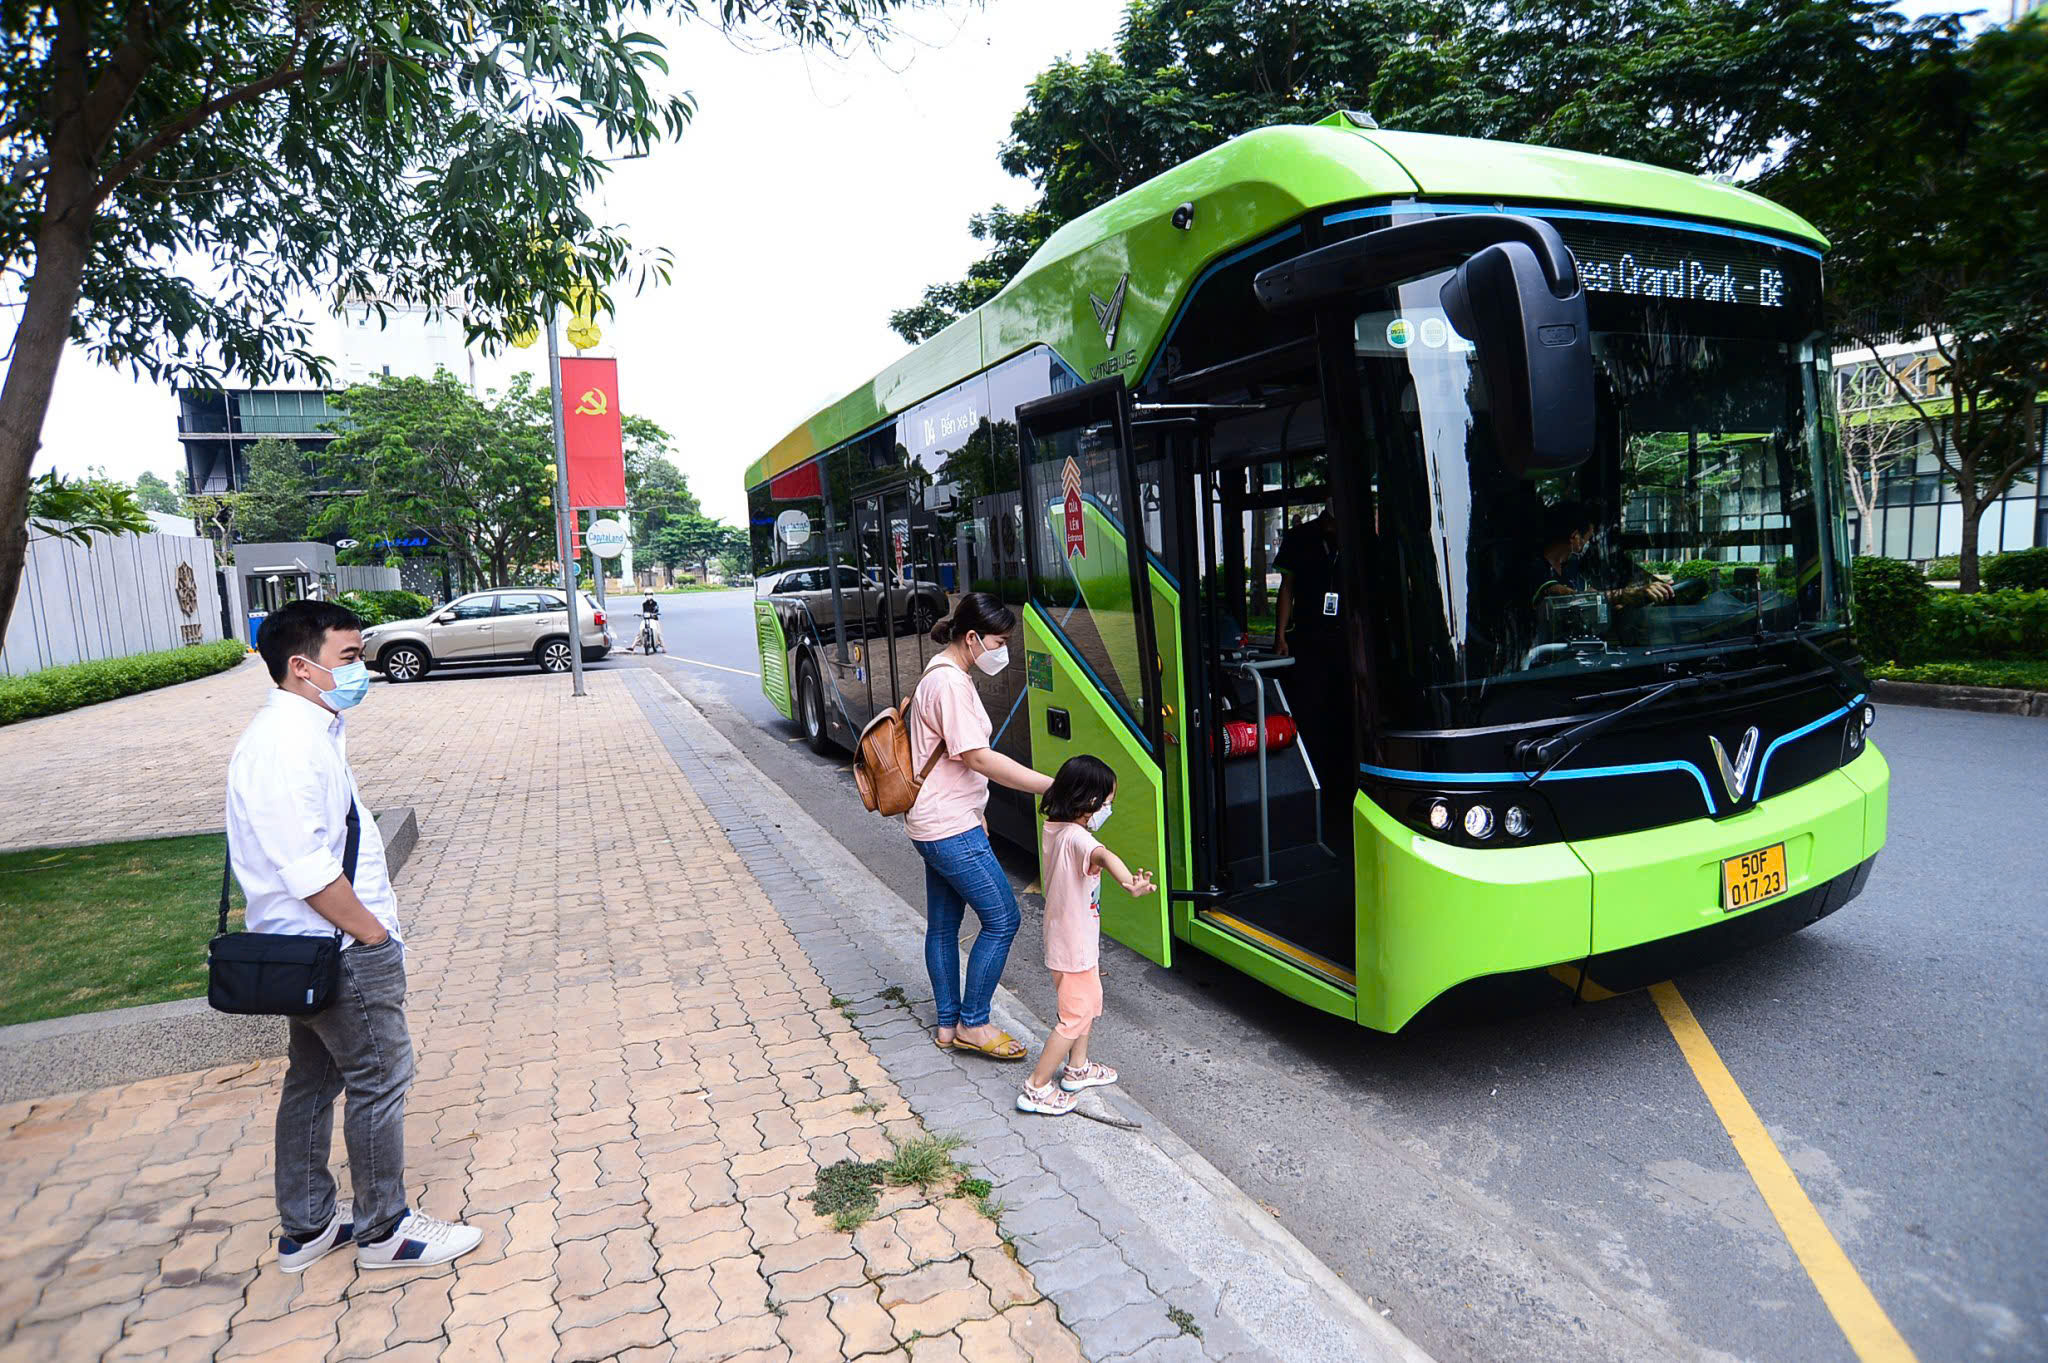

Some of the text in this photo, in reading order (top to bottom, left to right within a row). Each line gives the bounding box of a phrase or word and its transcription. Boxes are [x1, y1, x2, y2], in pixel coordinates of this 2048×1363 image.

[1619, 253, 1684, 298] Grand
[1690, 261, 1738, 303] Park
[1089, 349, 1137, 380] VINBUS
[588, 532, 624, 543] CapitaLand
[1741, 851, 1768, 878] 50F
[1731, 871, 1781, 906] 017.23
